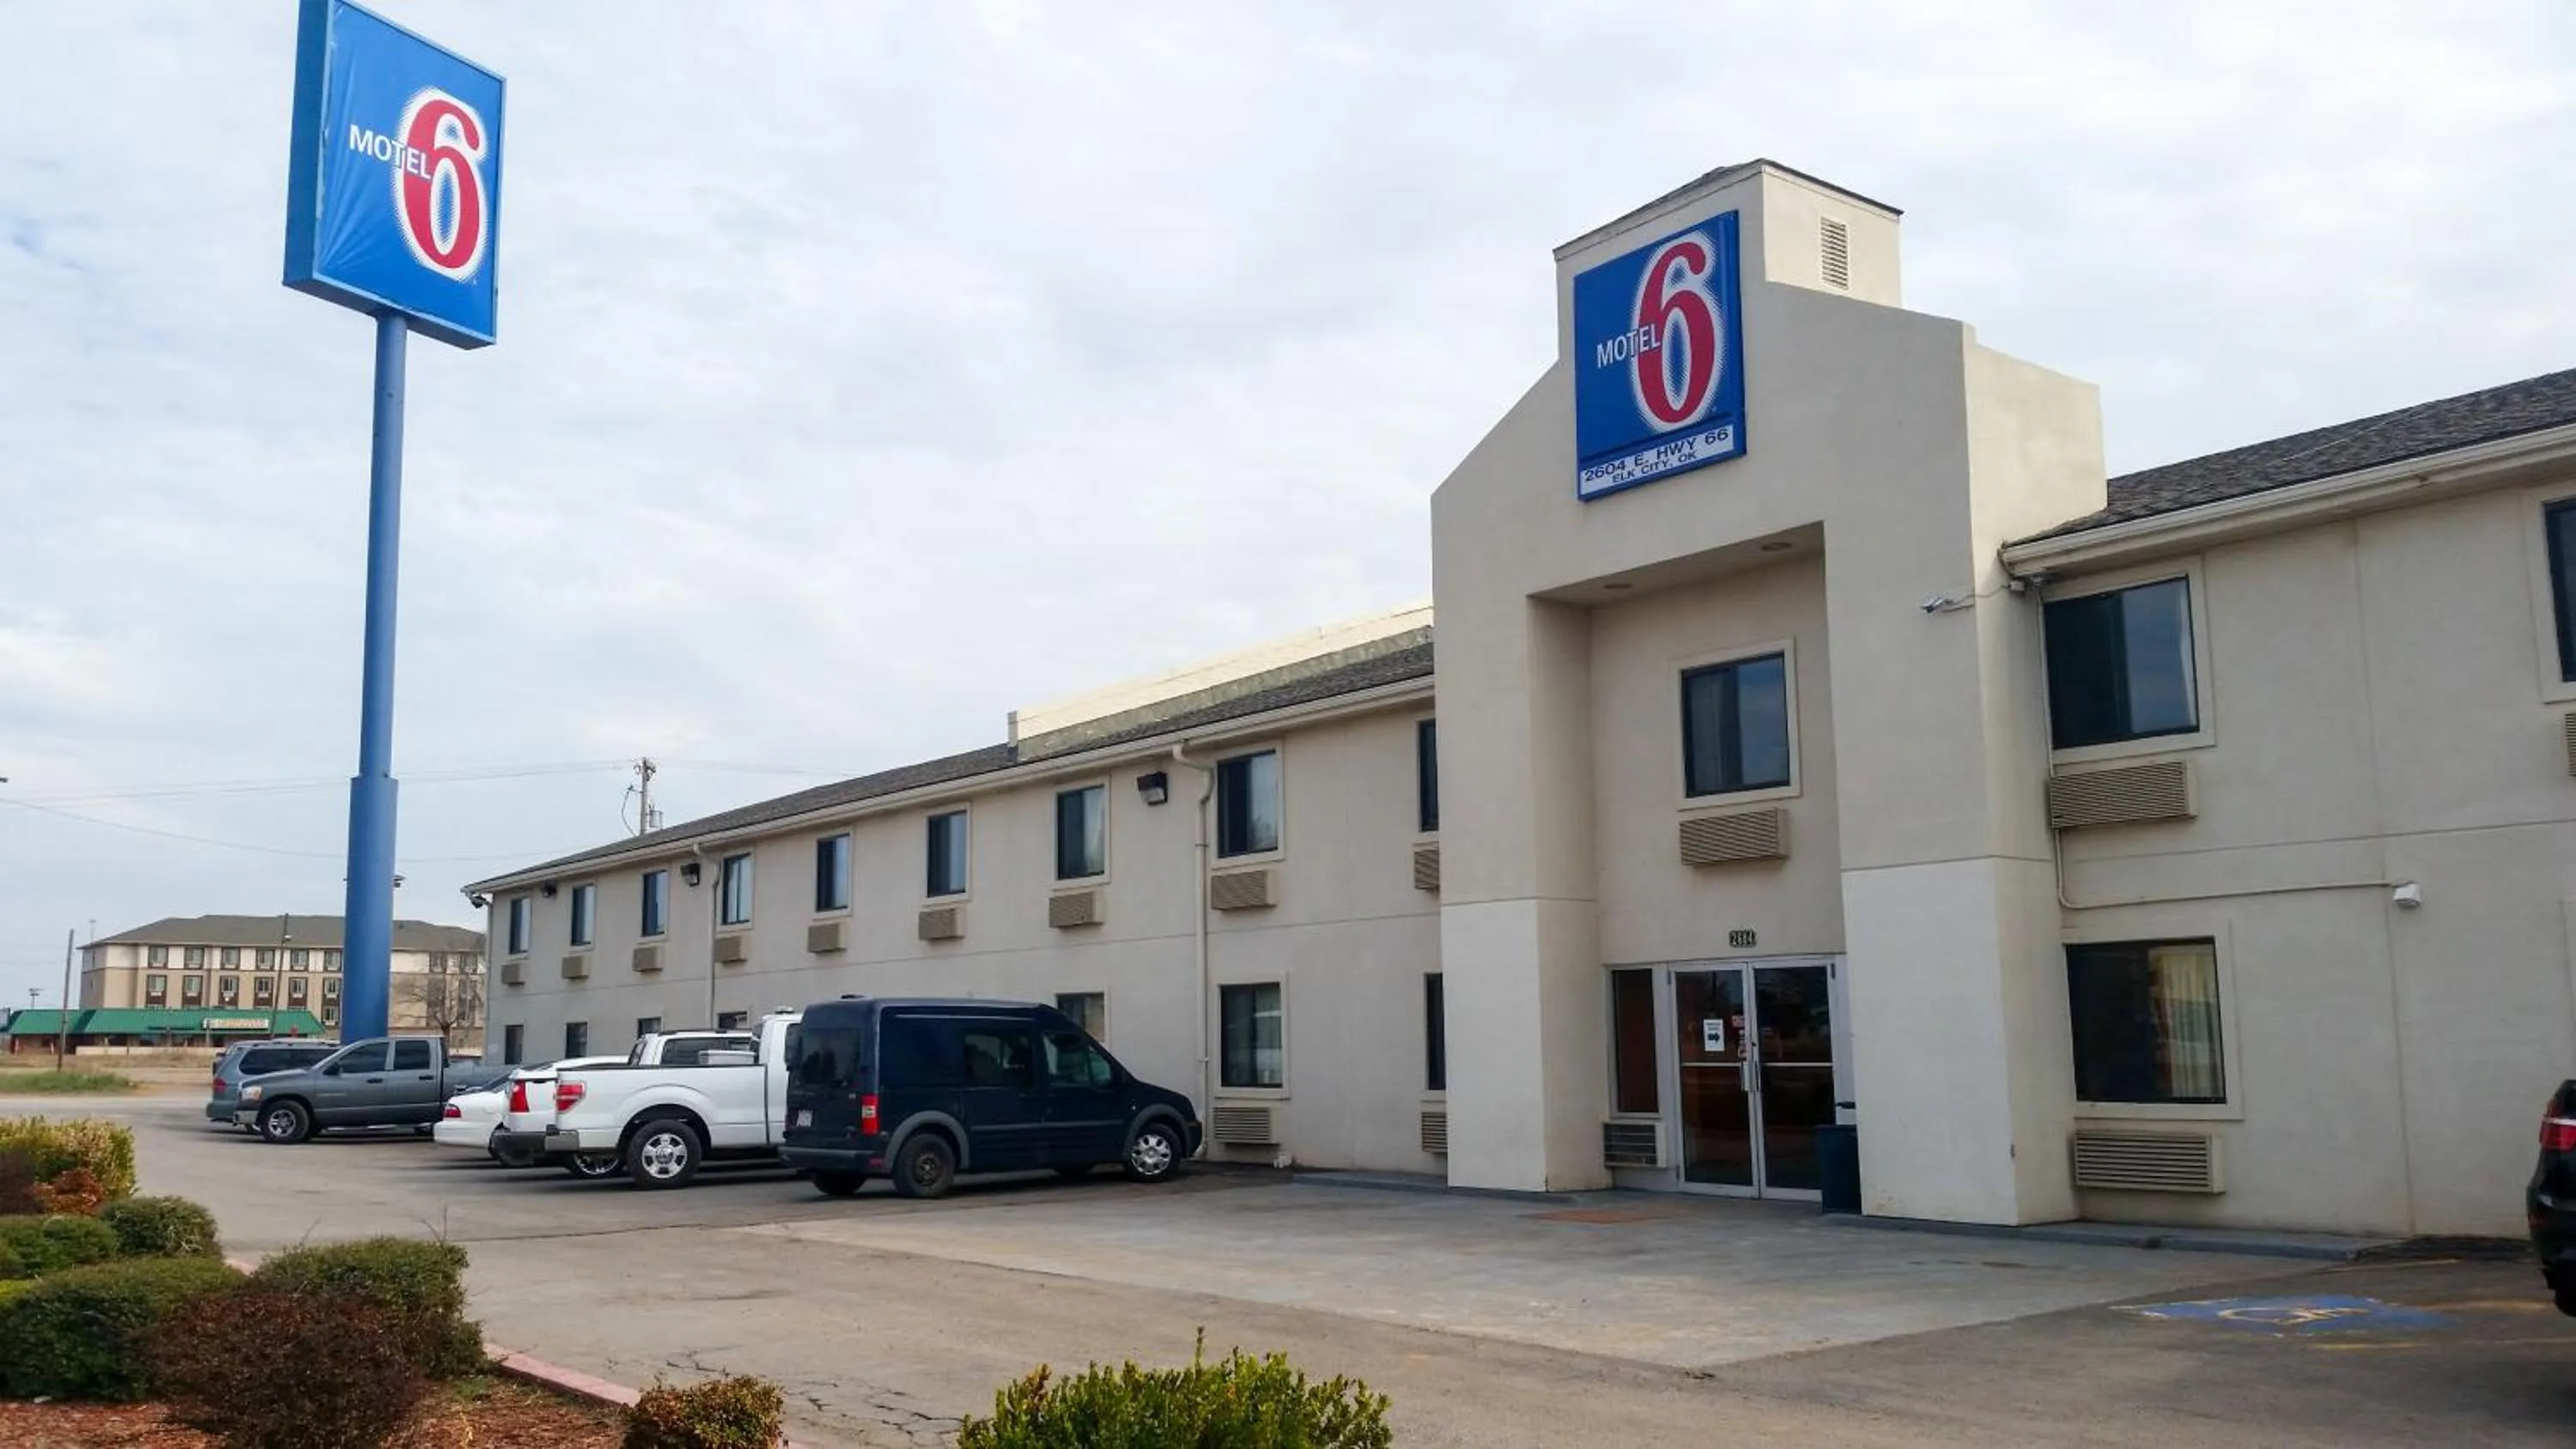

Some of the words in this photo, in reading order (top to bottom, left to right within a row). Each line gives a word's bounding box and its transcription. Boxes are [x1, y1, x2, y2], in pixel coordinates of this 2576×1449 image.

[349, 123, 431, 180] MOTEL
[398, 92, 483, 276] 6
[1596, 323, 1662, 369] MOTEL
[1635, 236, 1717, 427] 6
[1584, 459, 1626, 482] 2604
[1634, 452, 1649, 467] E.
[1656, 437, 1697, 460] HWY
[1704, 428, 1728, 446] 66
[1612, 469, 1636, 483] ELK
[1641, 458, 1674, 475] CITY,
[1678, 451, 1698, 463] OK
